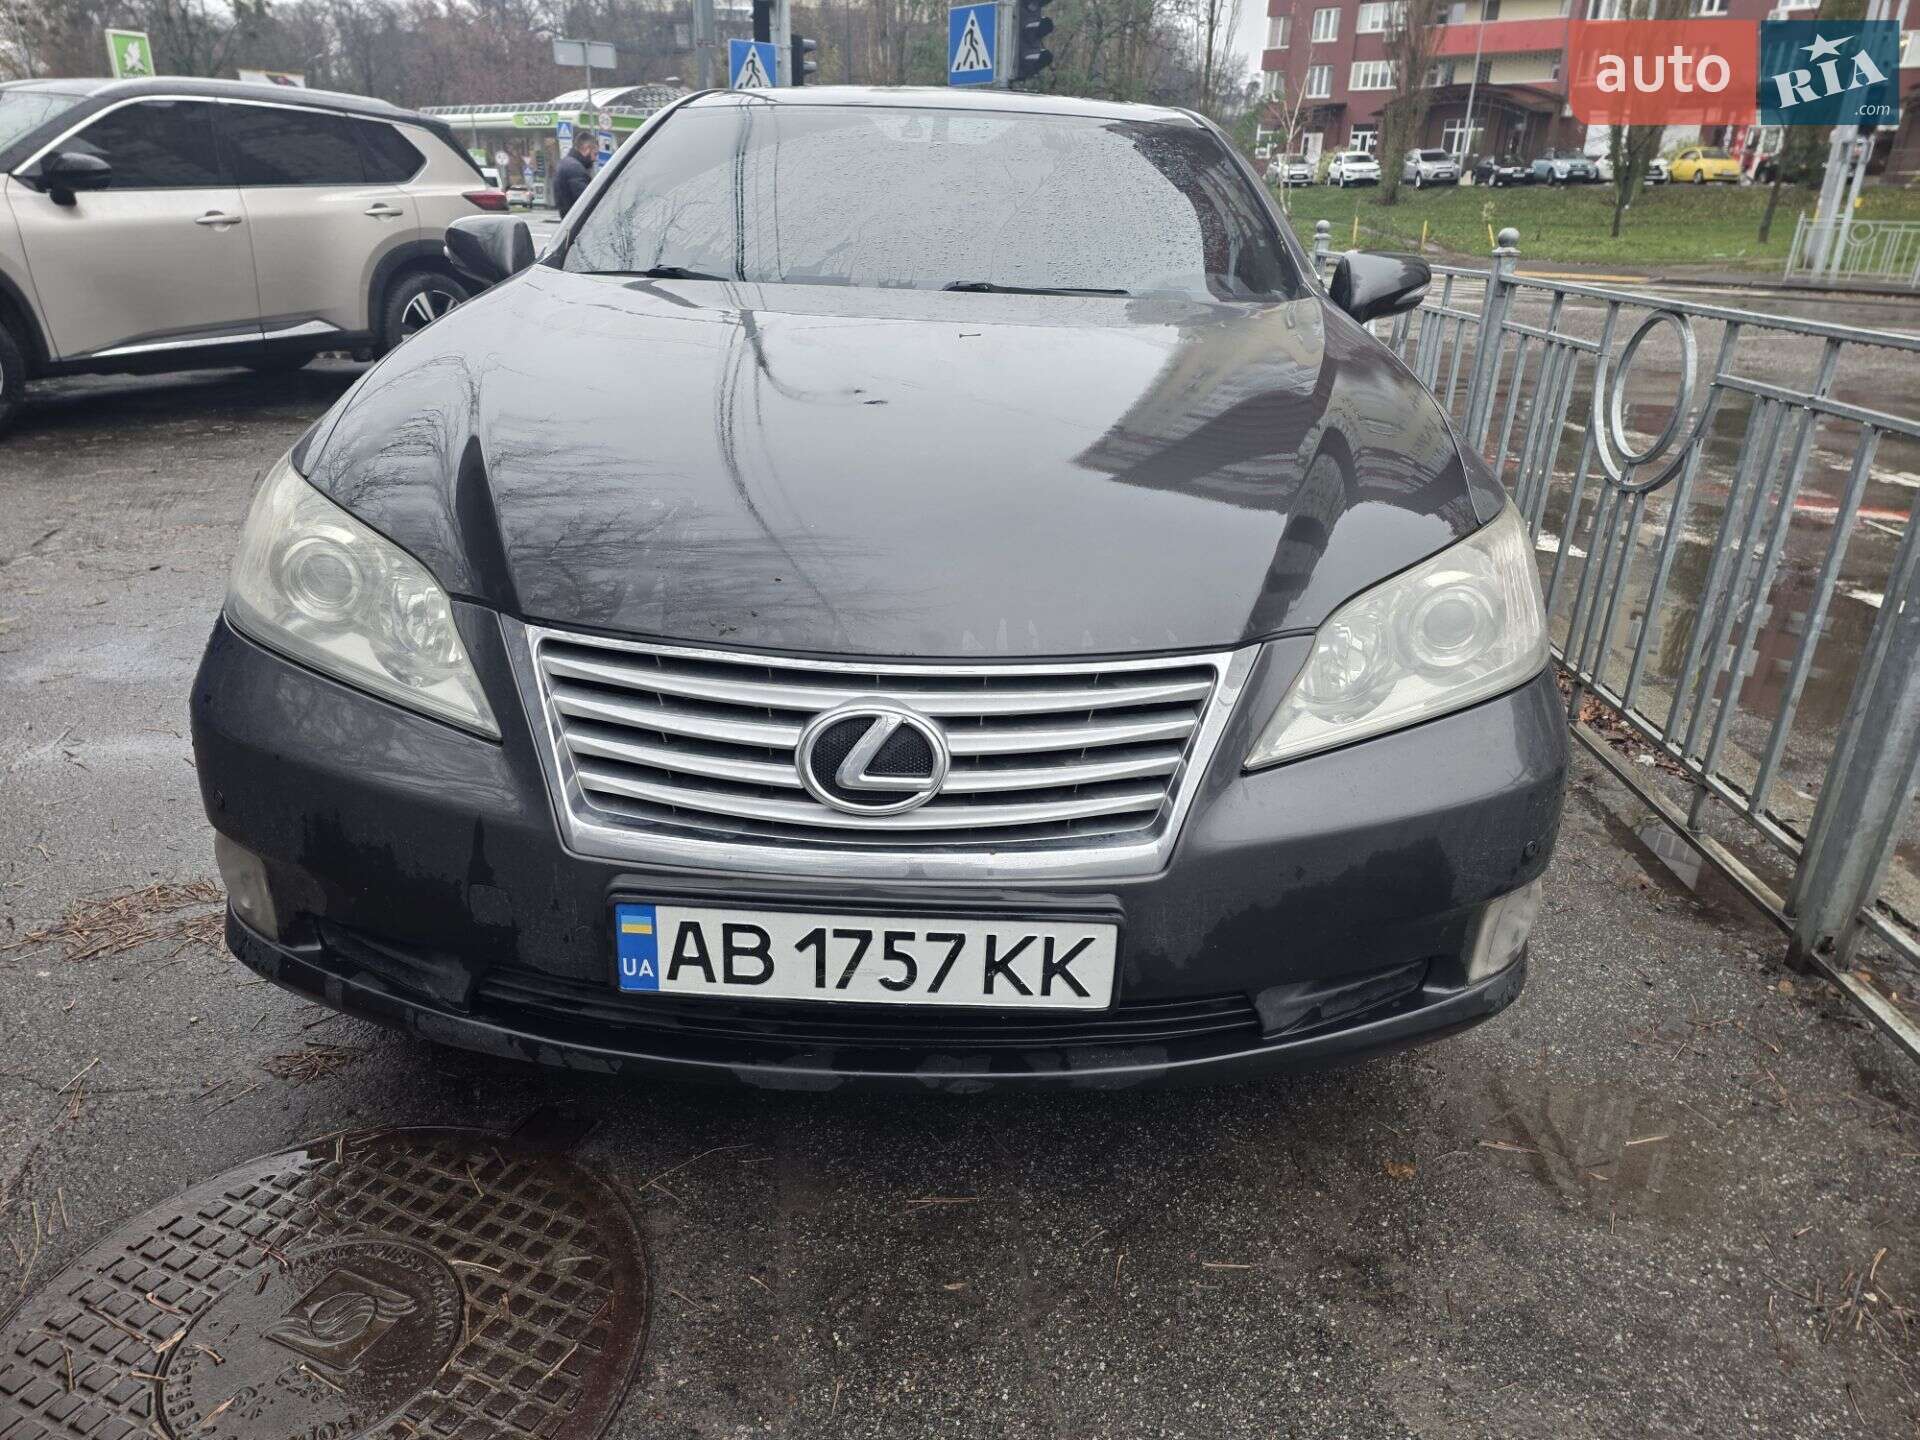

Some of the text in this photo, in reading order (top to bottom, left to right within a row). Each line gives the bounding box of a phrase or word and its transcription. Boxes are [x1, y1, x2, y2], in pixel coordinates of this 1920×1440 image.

[622, 957, 655, 978] UA
[666, 921, 1096, 998] AB 1757 KK
